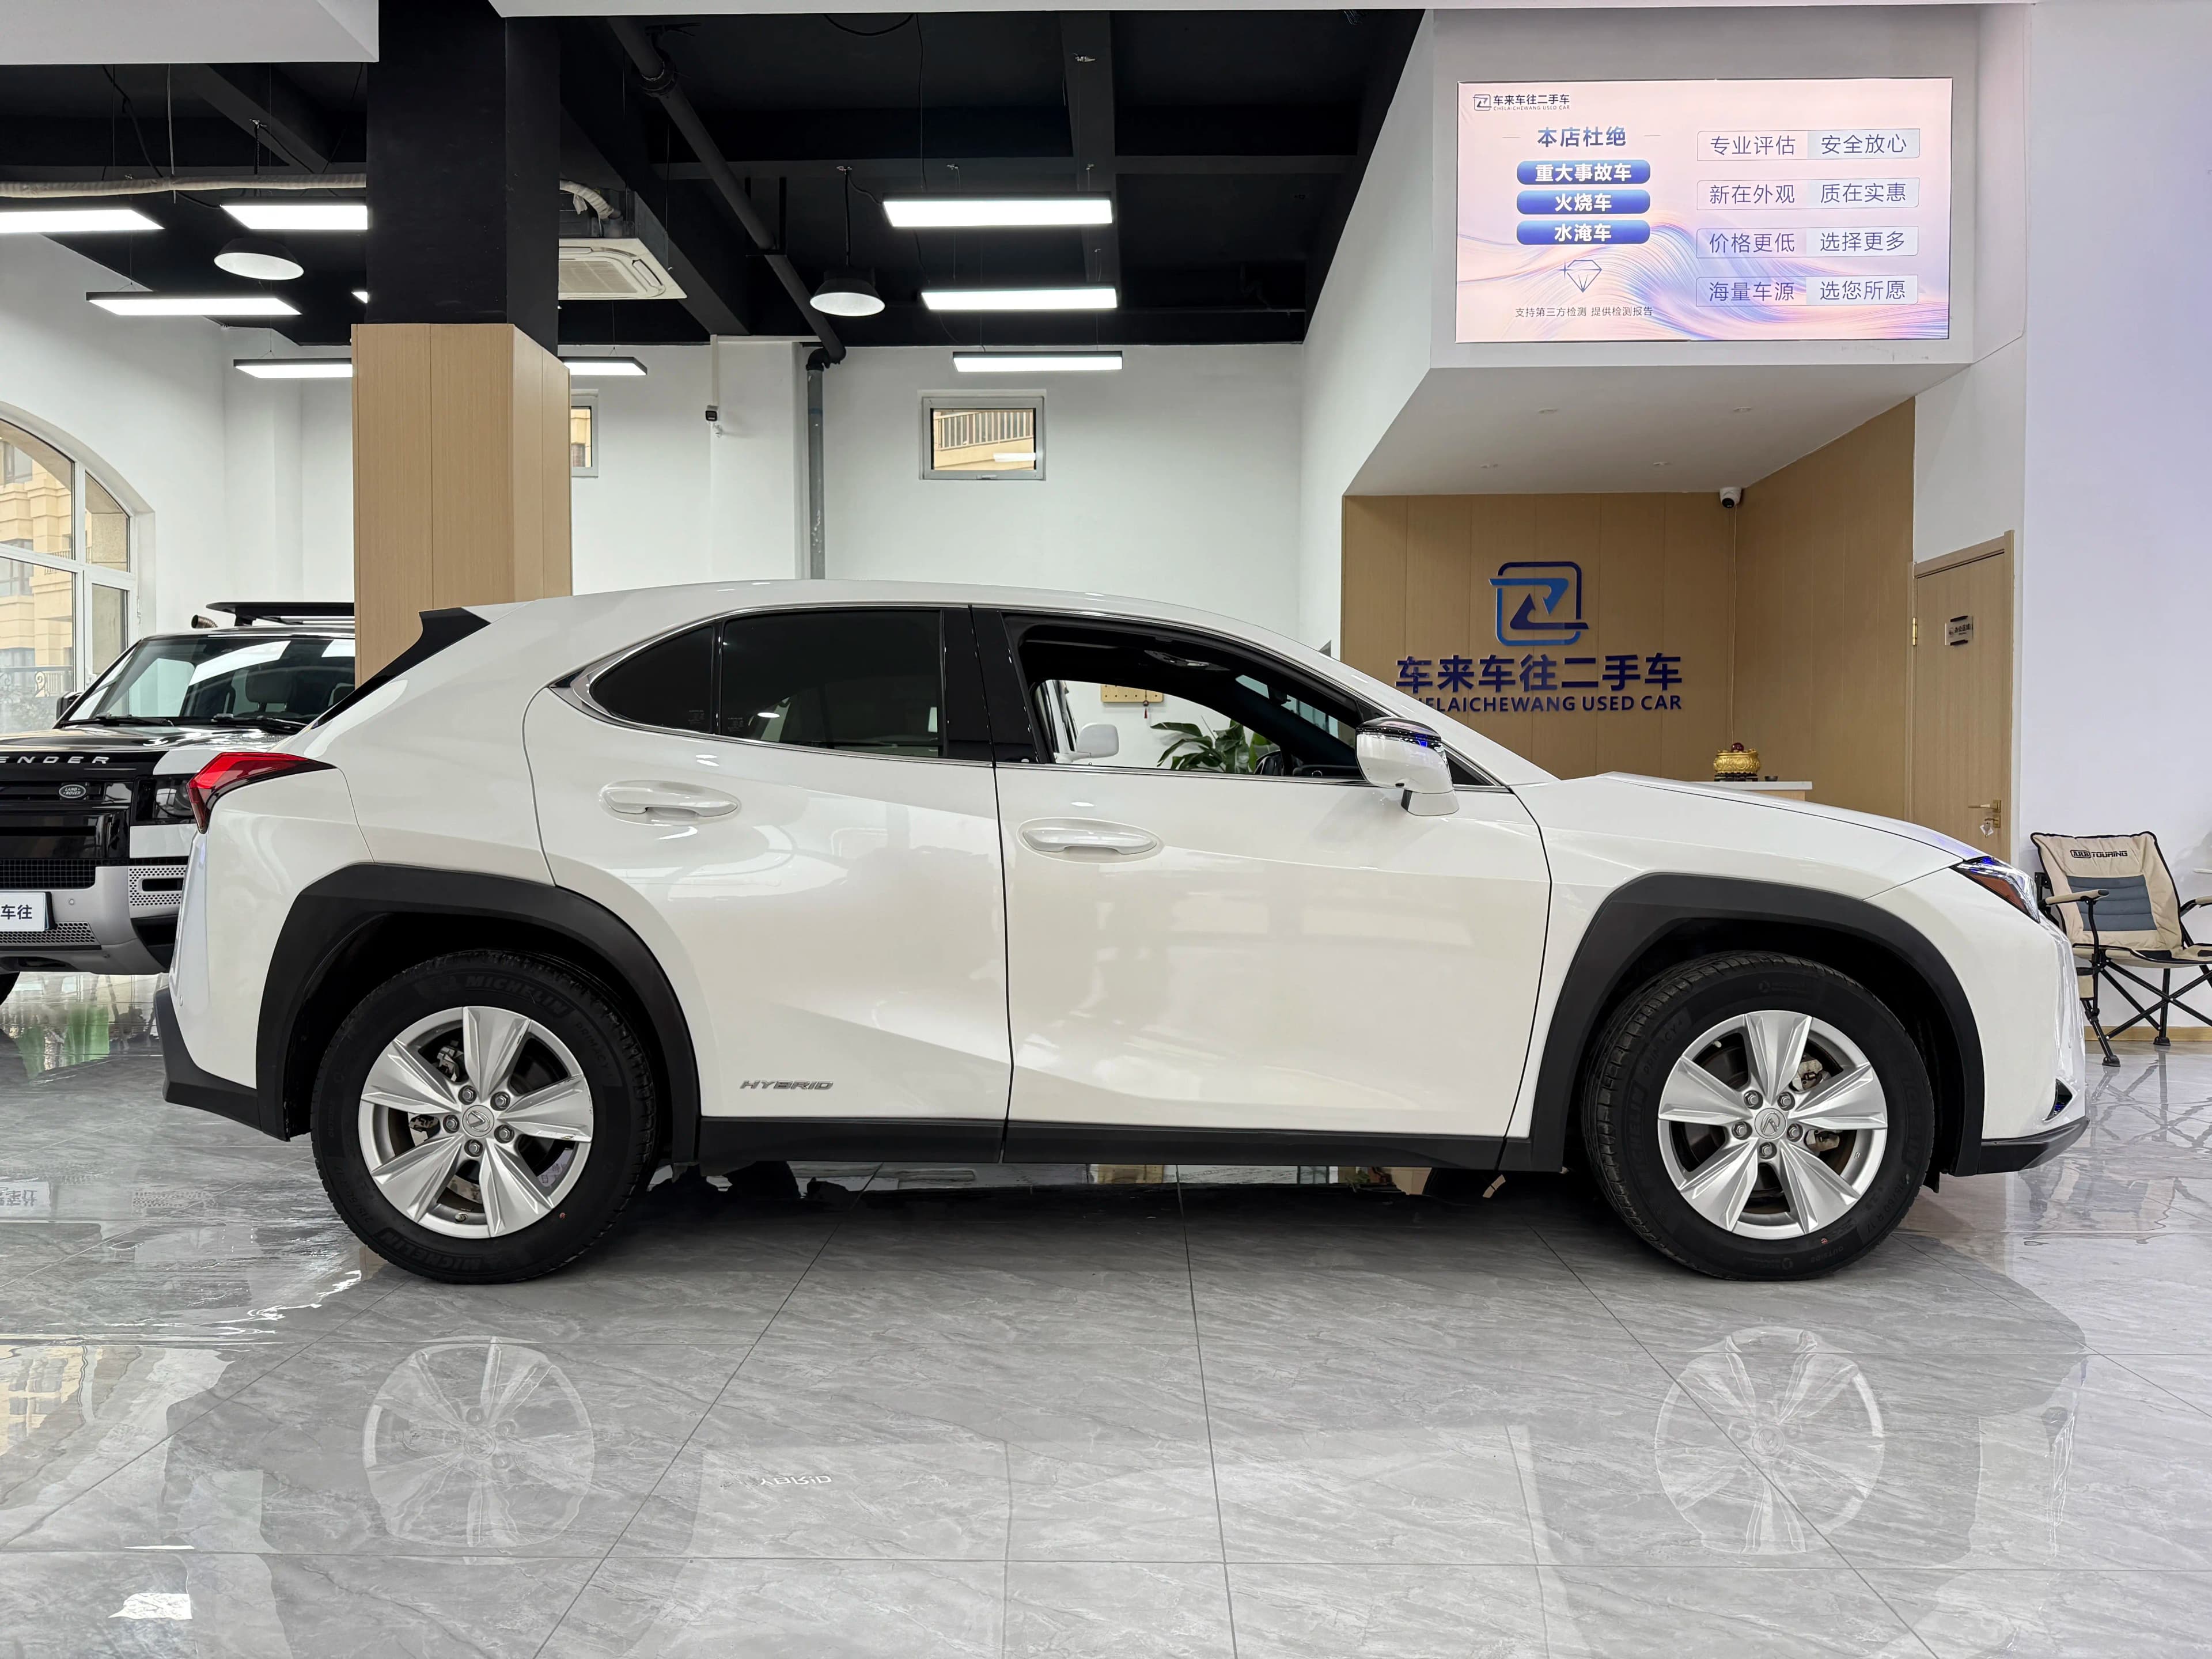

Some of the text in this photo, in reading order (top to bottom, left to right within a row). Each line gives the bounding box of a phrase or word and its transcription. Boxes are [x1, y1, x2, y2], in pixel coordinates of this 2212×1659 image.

[1493, 94, 1570, 105] 车来车往二手车
[1537, 126, 1626, 147] 本店杜绝
[1710, 133, 1907, 156] 专业评估 安全放心
[1535, 162, 1632, 182] 重大事故车
[1554, 193, 1612, 211] 火烧车
[1710, 182, 1907, 204] 新在外观 质在实惠
[1554, 223, 1612, 242] 水淹车
[1709, 230, 1906, 253] 价格更低 选择更多
[1709, 280, 1906, 302] 海量车源 选您所愿
[1515, 306, 1653, 317] 支持第三方检测 提供检测报告
[1396, 653, 1683, 694] 车来车往二手车
[1418, 695, 1682, 713] ELAICHEWANG USED CAR
[0, 904, 33, 920] 车往
[464, 975, 569, 1015] MICHELIN
[1643, 1024, 1677, 1074] PRIMCY
[740, 1080, 834, 1090] HYBRID
[378, 1232, 483, 1271] MICHELIN
